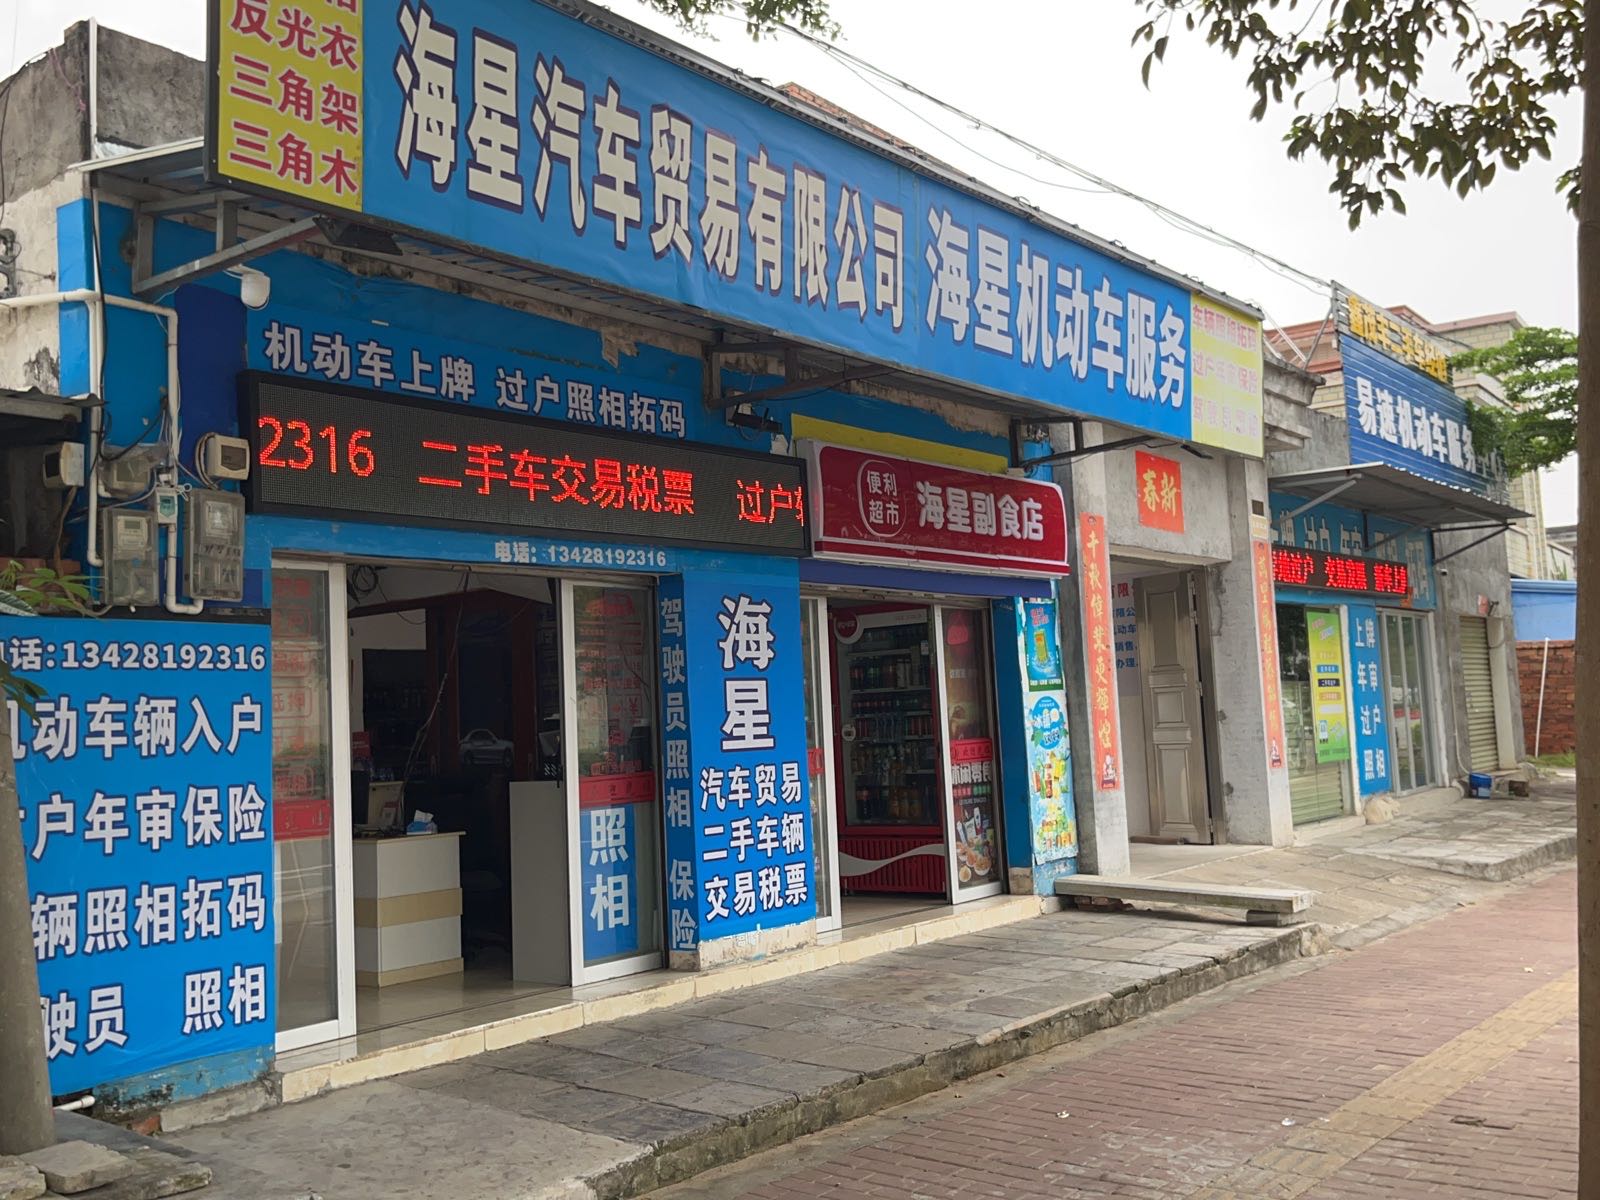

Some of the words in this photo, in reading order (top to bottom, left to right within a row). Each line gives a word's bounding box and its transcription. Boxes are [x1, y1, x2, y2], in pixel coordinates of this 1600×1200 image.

[231, 0, 358, 71] 反光衣
[230, 55, 358, 135] 三角架
[230, 121, 358, 195] 三角木
[395, 2, 905, 329] 海星汽车贸易有限公司
[925, 206, 1187, 408] 海星机动车服务
[264, 321, 476, 401] 机动车上牌
[495, 368, 686, 438] 过户照相拓码
[257, 416, 375, 477] 2316
[418, 440, 695, 515] 二手车交易税票
[866, 470, 898, 495] 便利
[868, 500, 900, 526] 超市
[916, 481, 1044, 541] 海星副食店
[0, 638, 266, 670] 话:13428192316
[718, 596, 776, 751] 海星
[661, 597, 692, 828] 驾驶员照相
[19, 784, 265, 860] 户年审保险
[700, 762, 802, 811] 汽车贸易
[589, 808, 630, 932] 照相
[702, 813, 805, 862] 二手车辆
[669, 859, 698, 950] 保险
[704, 862, 808, 920] 交易税票
[182, 965, 265, 1034] 照相
